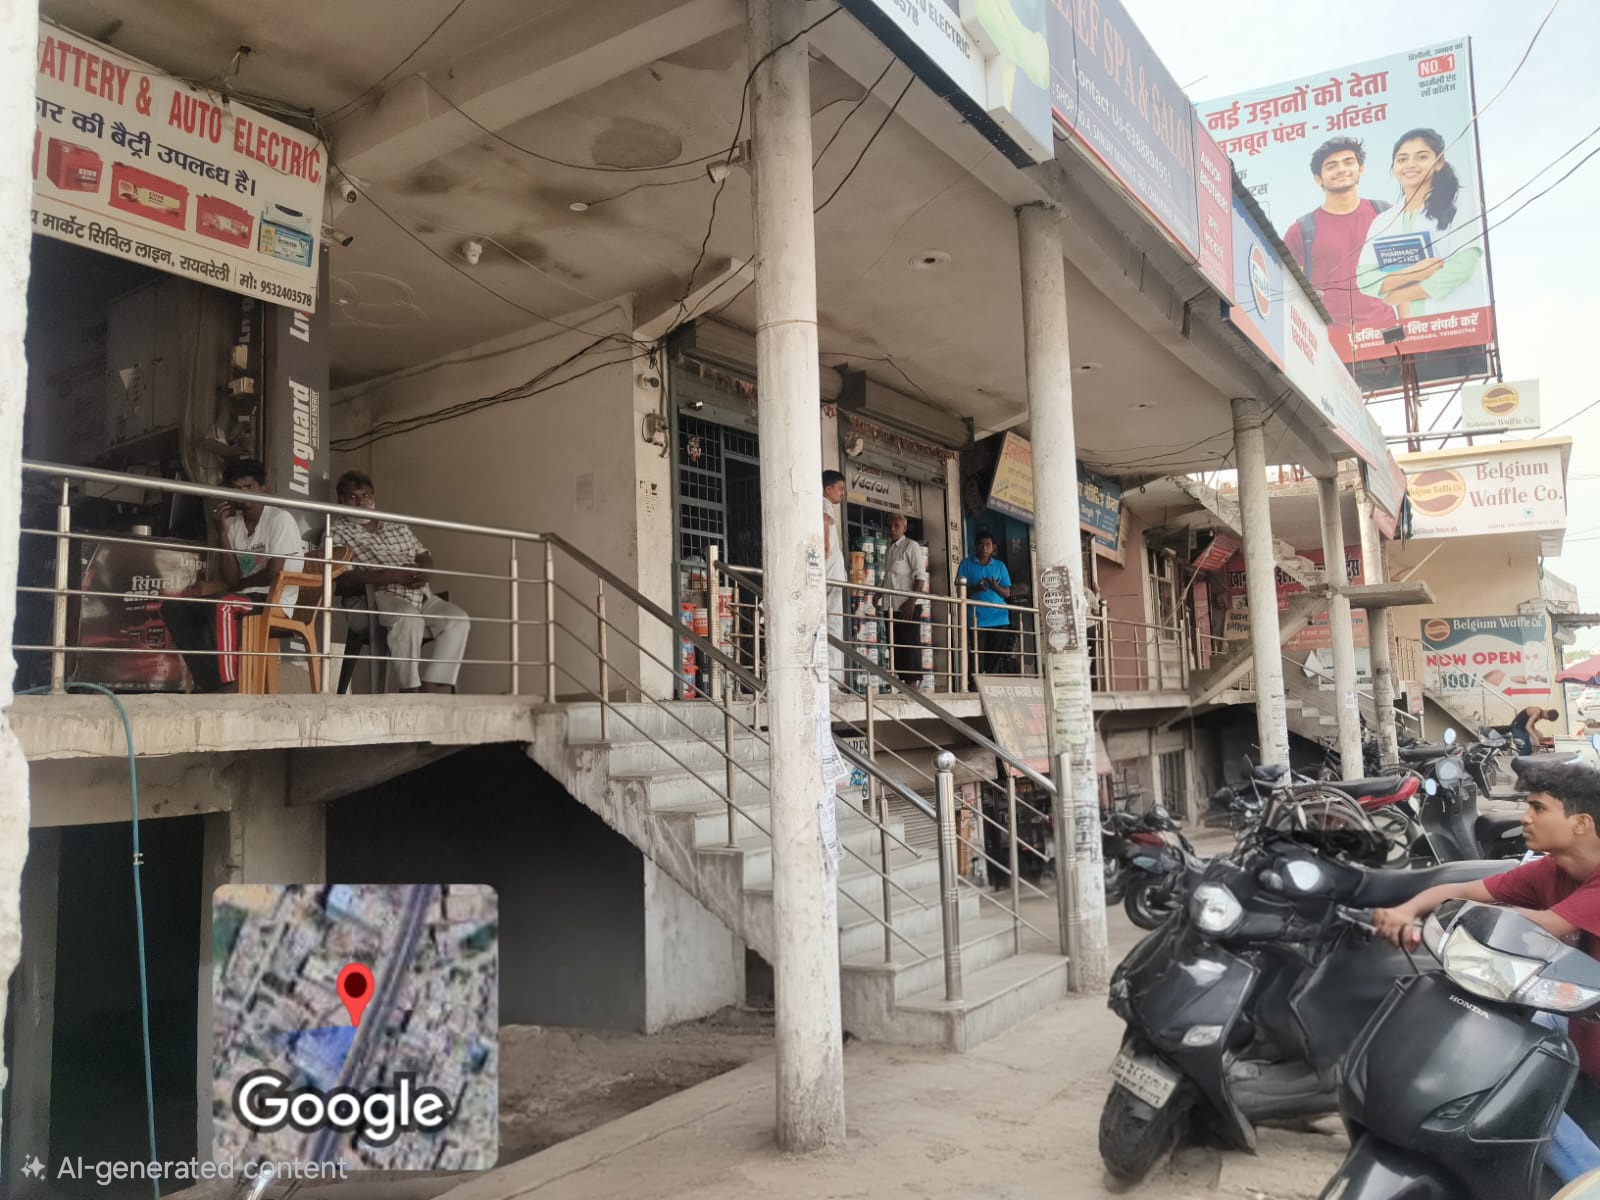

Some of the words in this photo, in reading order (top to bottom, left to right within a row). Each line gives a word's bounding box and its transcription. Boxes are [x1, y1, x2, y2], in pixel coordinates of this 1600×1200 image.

[893, 0, 919, 26] 578
[928, 3, 971, 59] ELECTRIC
[1072, 59, 1111, 114] Contact
[1103, 17, 1137, 107] SPA
[1138, 65, 1150, 124] &
[37, 36, 132, 106] ATTERY
[135, 75, 152, 117] &
[168, 90, 223, 144] AUTO
[233, 117, 322, 184] ELECTRIC
[1206, 100, 1240, 132] नई
[1247, 84, 1309, 126] उड़ानों
[1312, 78, 1344, 107] को
[1347, 71, 1389, 101] देता
[1272, 119, 1306, 145] पंख
[1325, 101, 1388, 132] अरिहंत
[36, 97, 66, 124] ार
[72, 107, 106, 139] की
[157, 142, 230, 187] उपलब्ध
[1200, 151, 1222, 184] ANOOP
[42, 214, 87, 239] मार्केट
[88, 221, 134, 254] सिविल
[260, 281, 313, 307] 9532403578
[1348, 327, 1384, 344] एडमिश
[1408, 320, 1428, 334] लिए
[1431, 317, 1458, 331] संपर्क
[289, 376, 315, 495] Livguard
[1476, 461, 1549, 482] Belgium
[1469, 486, 1528, 507] Waffle
[1534, 485, 1563, 502] Co.
[1453, 617, 1497, 632] Belgium
[1499, 616, 1531, 629] Waffle
[1426, 653, 1467, 667] NOW
[1472, 651, 1522, 666] OPEN
[1448, 994, 1490, 1021] HONDA
